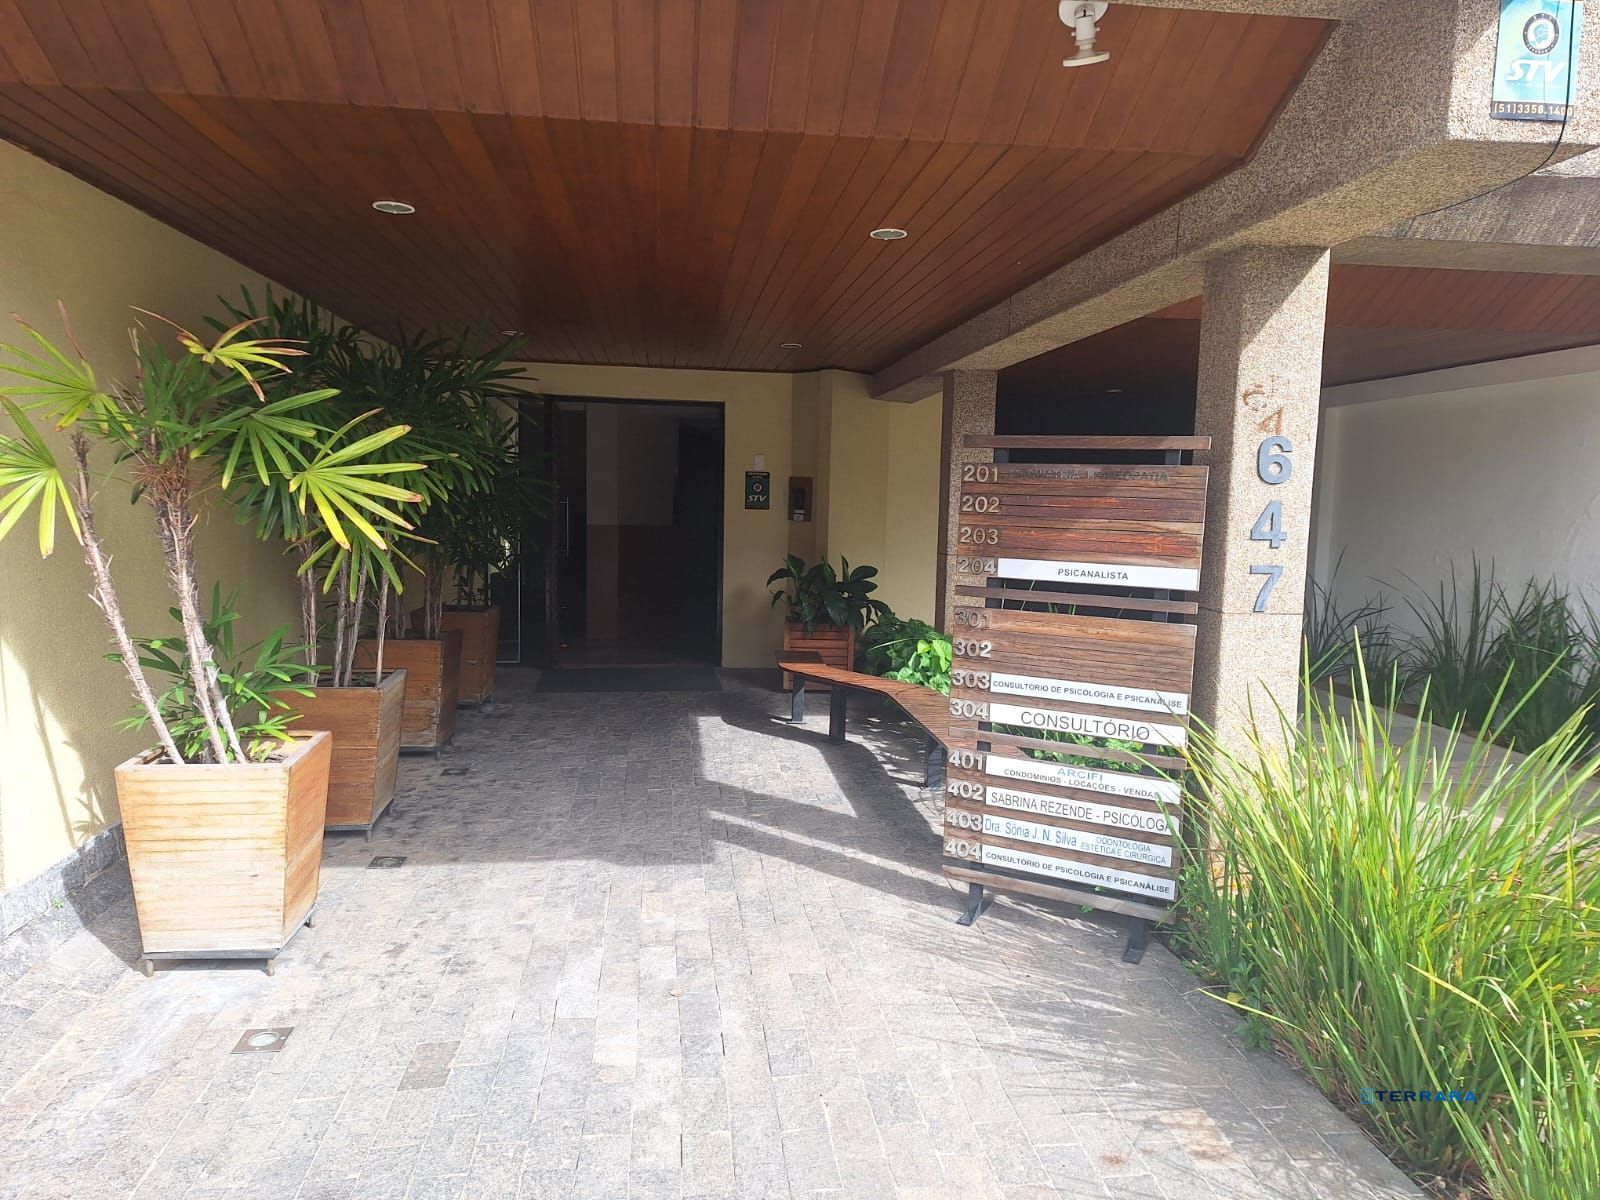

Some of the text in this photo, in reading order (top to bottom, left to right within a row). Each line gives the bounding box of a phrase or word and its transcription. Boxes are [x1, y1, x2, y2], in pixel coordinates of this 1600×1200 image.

[1506, 59, 1568, 81] STV
[964, 464, 999, 483] 201
[961, 495, 1000, 513] 202
[960, 526, 999, 545] 203
[957, 557, 998, 576] 204
[1057, 567, 1129, 581] PSICANALISTA
[954, 608, 992, 629] 301
[954, 639, 992, 659] 302
[951, 669, 991, 690] 303
[1050, 684, 1062, 694] DE
[1063, 686, 1115, 701] PSICOLOGIA
[1116, 692, 1123, 701] E
[950, 699, 989, 720] 304
[1020, 711, 1150, 741] CONSULTÓRIO
[948, 750, 984, 770] 401
[1056, 767, 1103, 782] ARCIFI
[947, 778, 984, 801] 402
[1123, 787, 1160, 799] VENDAS
[991, 791, 1038, 812] SABRINA
[1040, 800, 1093, 820] REZENDE
[946, 808, 982, 831] 403
[984, 820, 1077, 847] Dra. Sônia J. N. Silva
[945, 839, 982, 860] 404
[1097, 836, 1151, 853] ODONTOLOGIA
[1042, 862, 1053, 871] DE
[1055, 865, 1105, 881] PSICOLOGIA
[1106, 874, 1112, 882] E
